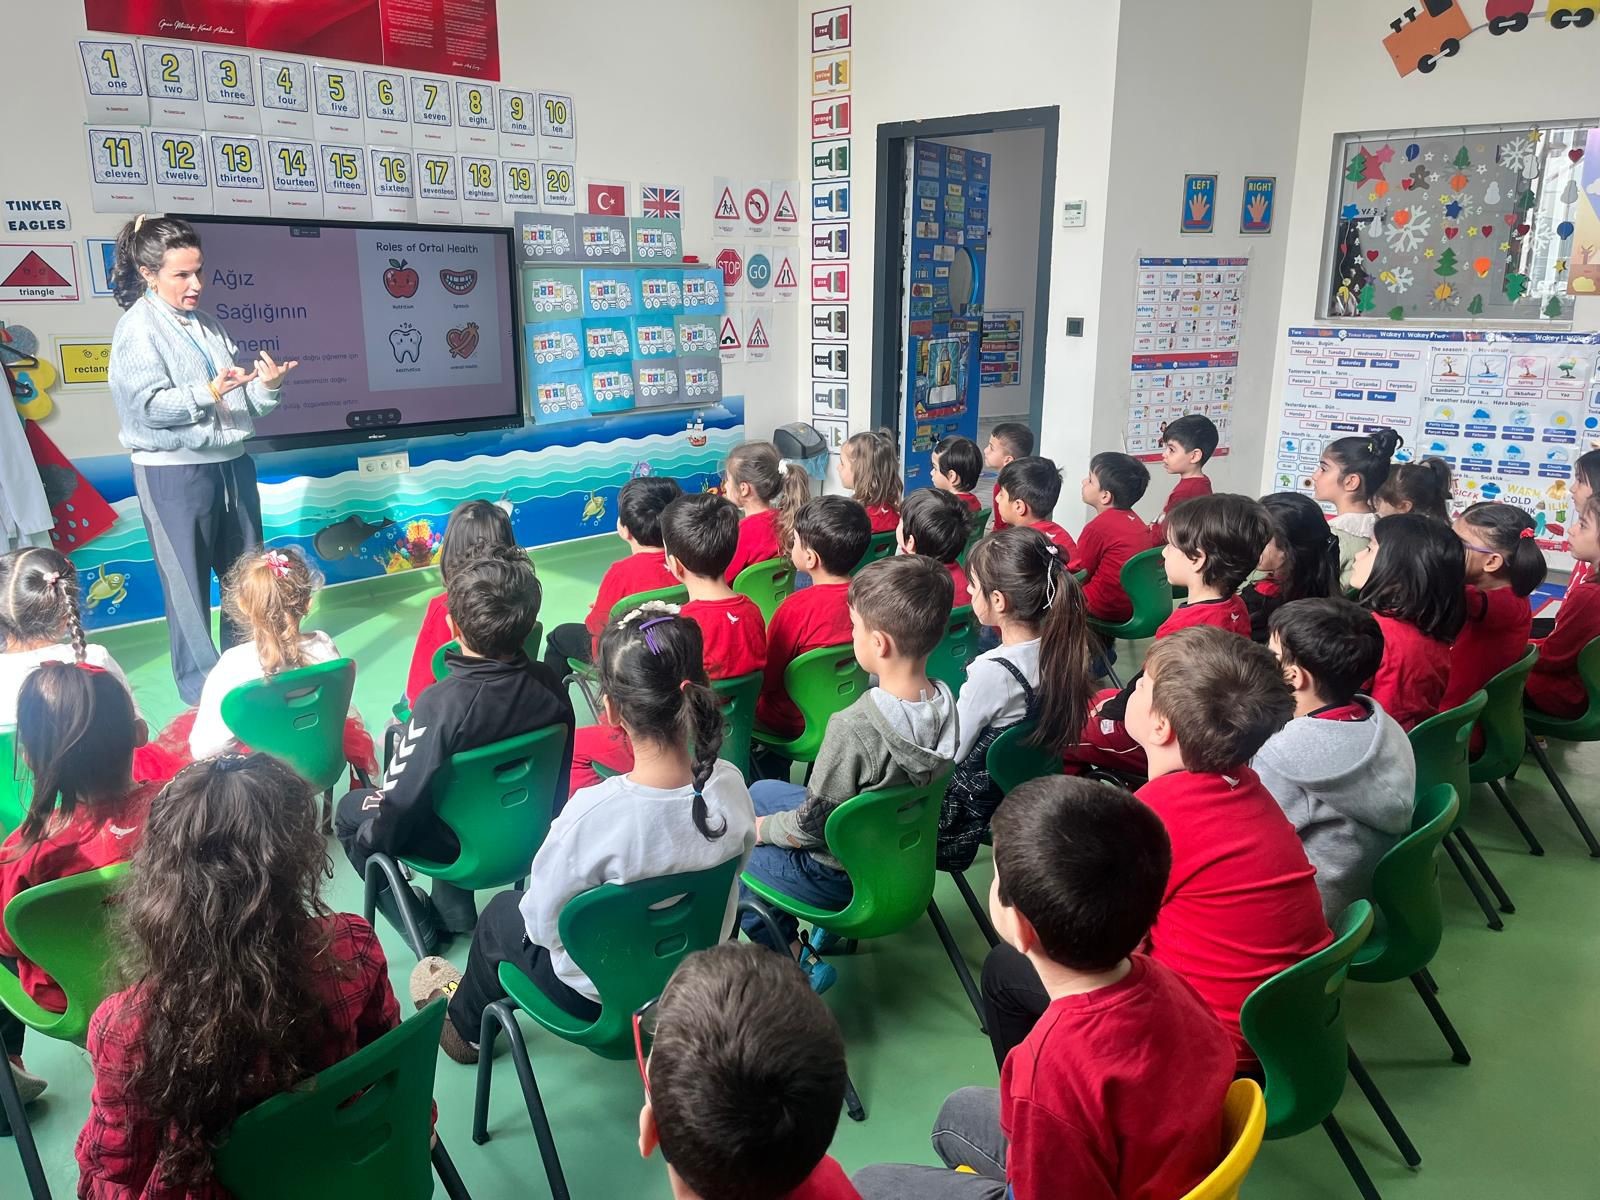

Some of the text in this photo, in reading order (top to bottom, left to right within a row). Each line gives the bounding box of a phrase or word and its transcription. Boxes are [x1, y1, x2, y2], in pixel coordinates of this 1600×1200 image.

[102, 49, 120, 78] 1
[161, 54, 180, 82] 2
[220, 60, 238, 88] 3
[277, 68, 292, 94] 4
[164, 84, 183, 94] two
[220, 89, 246, 100] three
[328, 74, 345, 102] 5
[378, 80, 394, 105] 6
[278, 95, 297, 105] four
[424, 84, 438, 110] 7
[468, 90, 482, 114] 8
[331, 102, 348, 113] five
[382, 108, 394, 116] six
[510, 96, 524, 120] 9
[546, 100, 566, 124] 10
[423, 113, 446, 122] seven
[469, 116, 487, 125] eight
[103, 137, 132, 168] 11
[162, 139, 196, 169] 12
[222, 144, 253, 173] 13
[279, 148, 307, 176] 14
[330, 152, 358, 180] 15
[105, 169, 140, 179] eleven
[166, 170, 198, 181] twelve
[380, 157, 406, 183] 16
[426, 160, 448, 185] 17
[469, 163, 492, 188] 18
[220, 174, 258, 184] thirteen
[276, 176, 315, 187] fourteen
[333, 180, 361, 190] fifteen
[509, 168, 531, 190] 19
[547, 170, 570, 192] 20
[1192, 180, 1210, 190] LEFT
[380, 184, 410, 193] sixteen
[468, 189, 494, 198] eighteen
[1248, 183, 1272, 191] RIGHT
[6, 200, 62, 211] TINKER
[8, 220, 66, 231] EAGLES
[377, 242, 478, 253] Roles of Ortal Health
[718, 260, 740, 275] STOP
[750, 264, 767, 280] GO
[212, 269, 255, 290] Ağız
[19, 288, 54, 297] triangle
[216, 303, 307, 323] Sağlığının
[236, 336, 280, 352] nemi
[1535, 334, 1559, 342] Wakey
[74, 364, 109, 374] rectan
[1507, 484, 1540, 496] WARM
[1504, 496, 1531, 505] COLD
